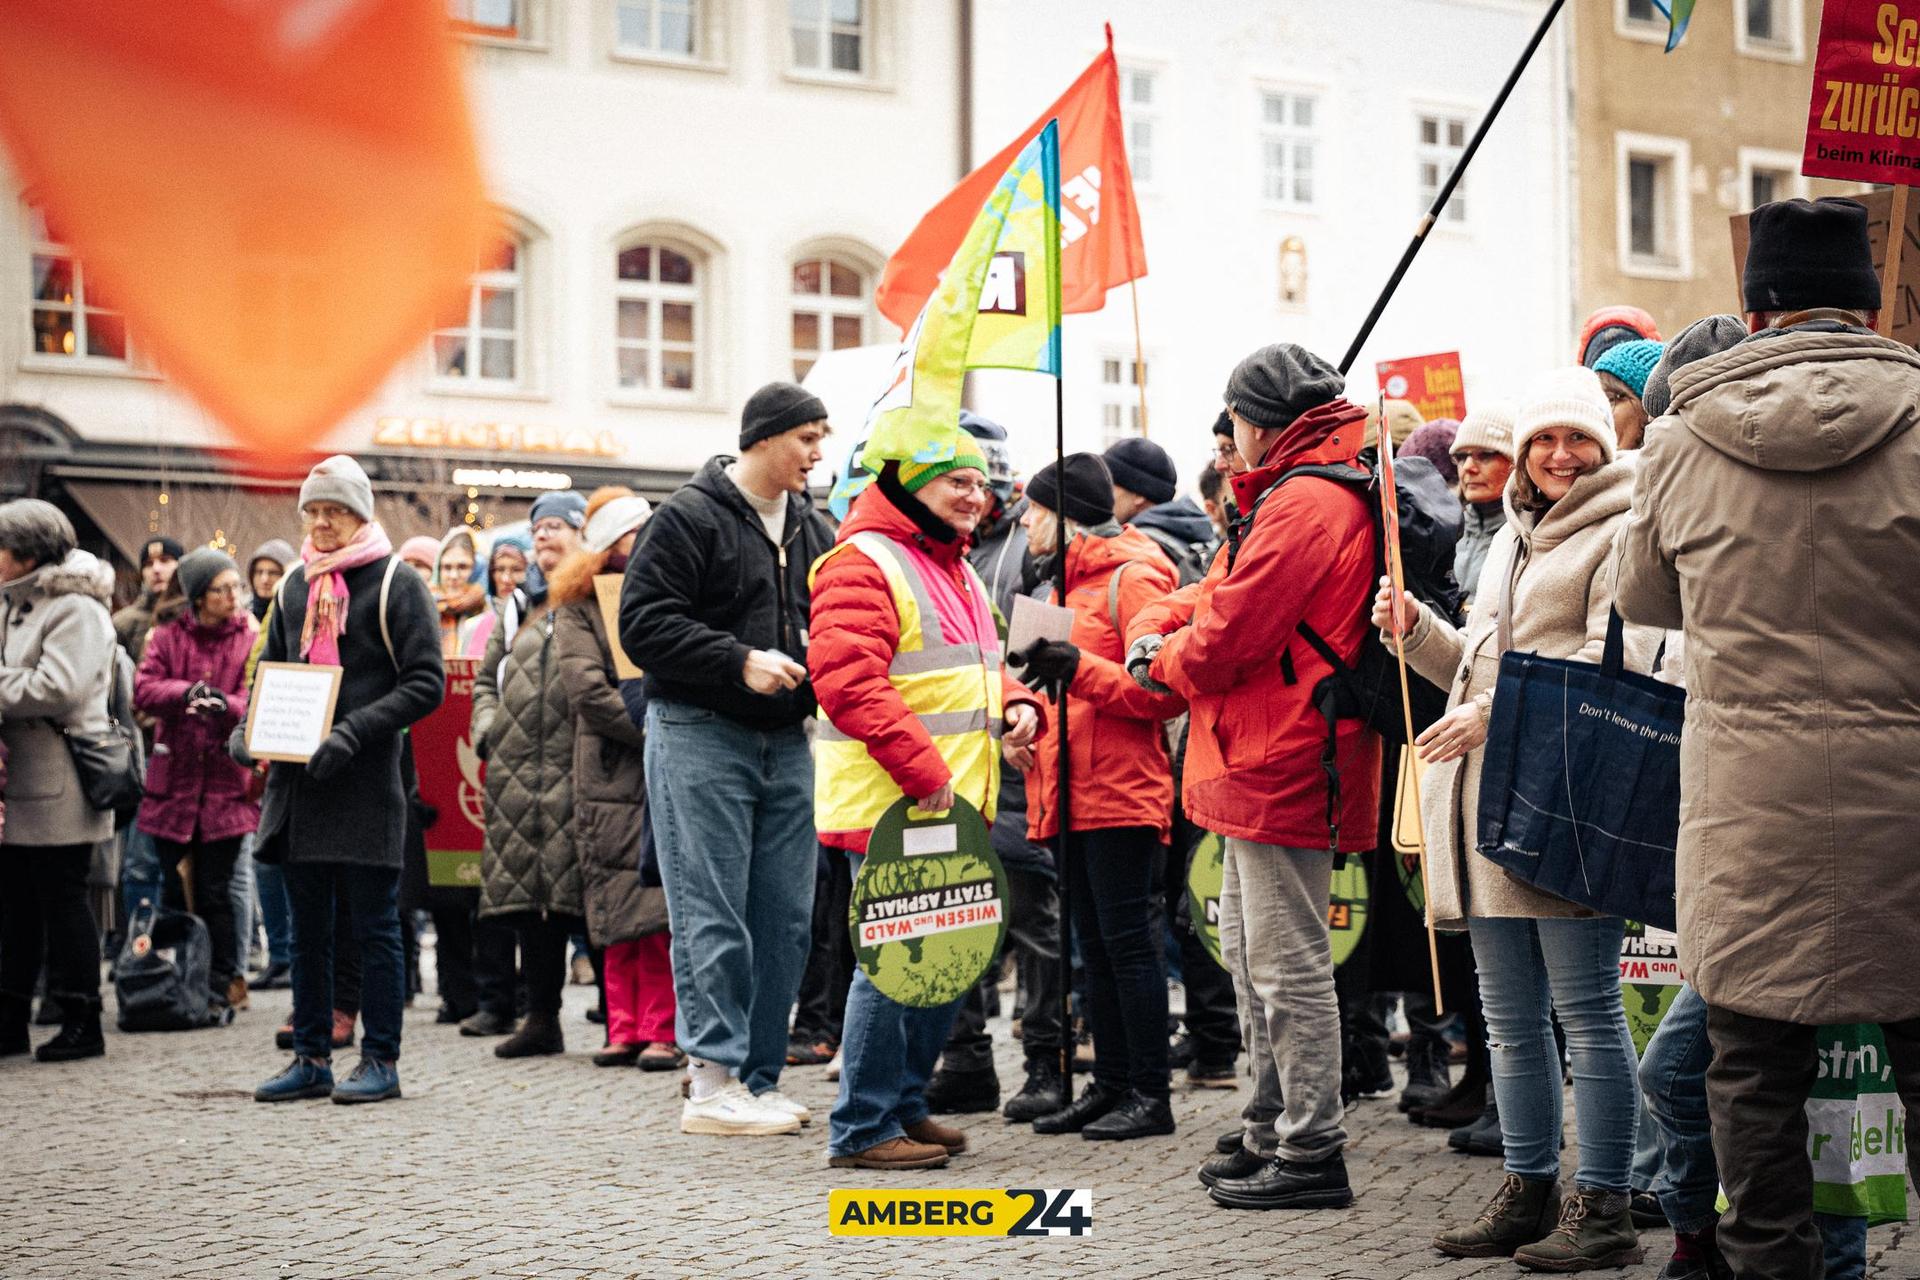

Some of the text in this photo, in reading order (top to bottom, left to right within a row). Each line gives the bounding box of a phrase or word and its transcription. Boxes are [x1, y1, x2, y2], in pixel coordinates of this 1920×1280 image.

[1872, 3, 1920, 67] Sc
[1820, 73, 1920, 139] zurüc
[1816, 143, 1864, 164] beim
[1579, 702, 1611, 721] Don't
[1611, 711, 1638, 733] leave
[1639, 725, 1658, 739] the
[865, 882, 993, 920] STATT ASPHALT
[865, 904, 997, 940] WIESEN UND WALD
[1652, 962, 1677, 973] UND
